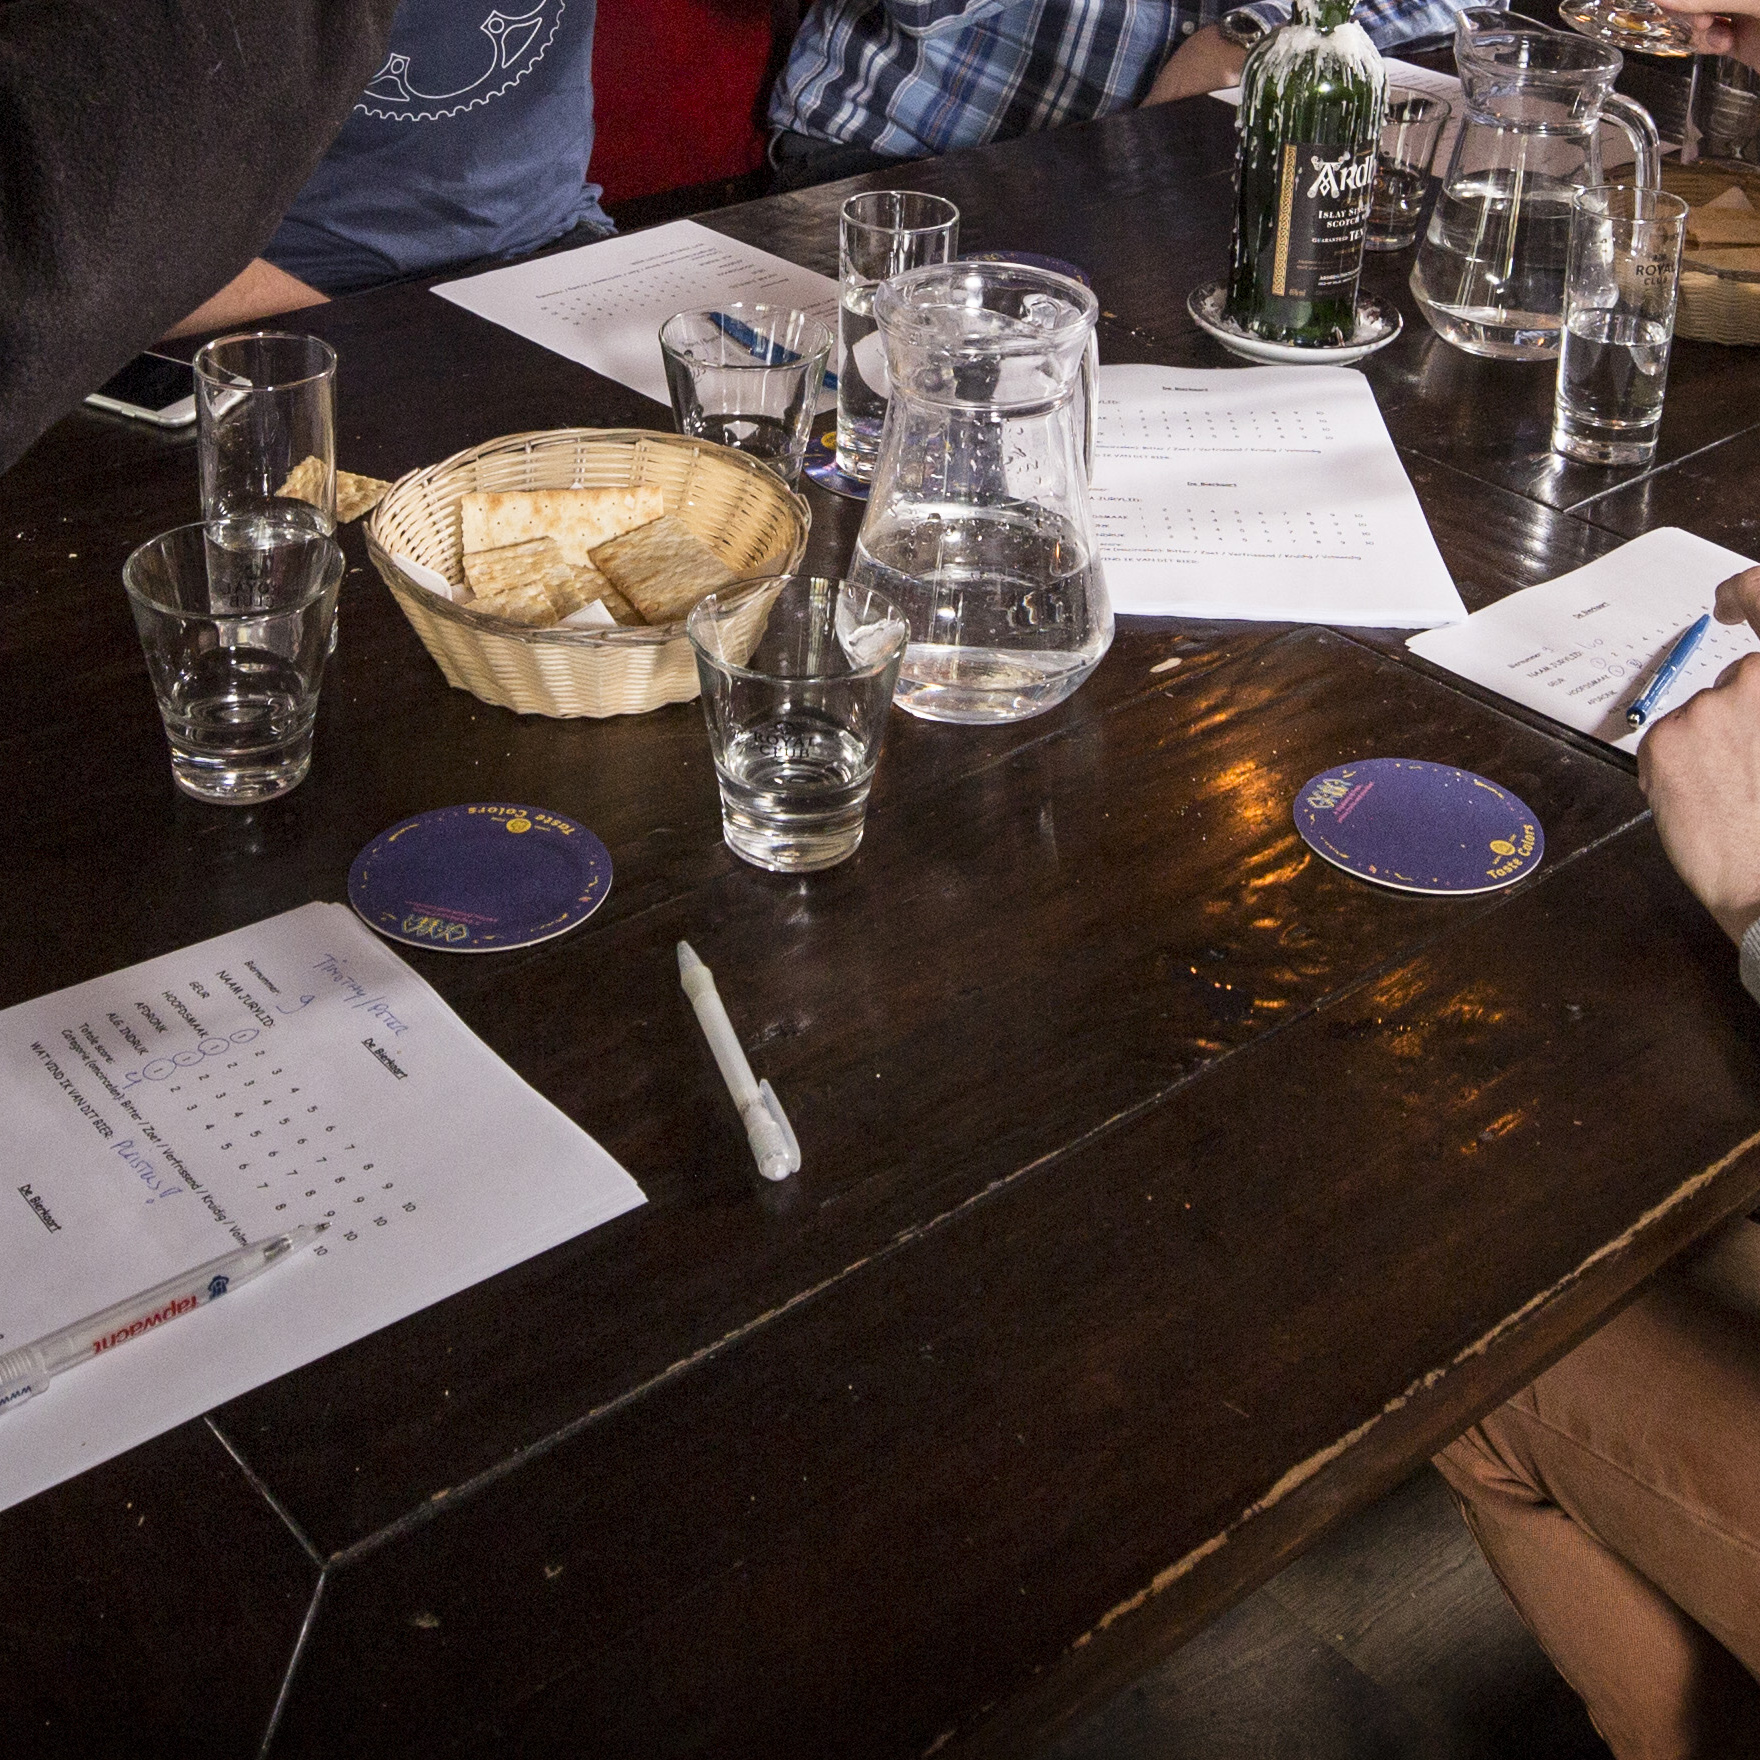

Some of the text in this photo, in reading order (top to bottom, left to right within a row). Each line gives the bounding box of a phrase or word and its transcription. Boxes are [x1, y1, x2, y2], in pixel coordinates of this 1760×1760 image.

[1486, 857, 1524, 880] Taste
[189, 980, 210, 1000] GEUR
[134, 1001, 168, 1036] AFDRONK
[161, 990, 210, 1039] HOOFDSMAAK
[142, 1124, 162, 1145] Zoet
[161, 1146, 202, 1192] Verfrissend
[201, 1192, 227, 1225] Kruidig
